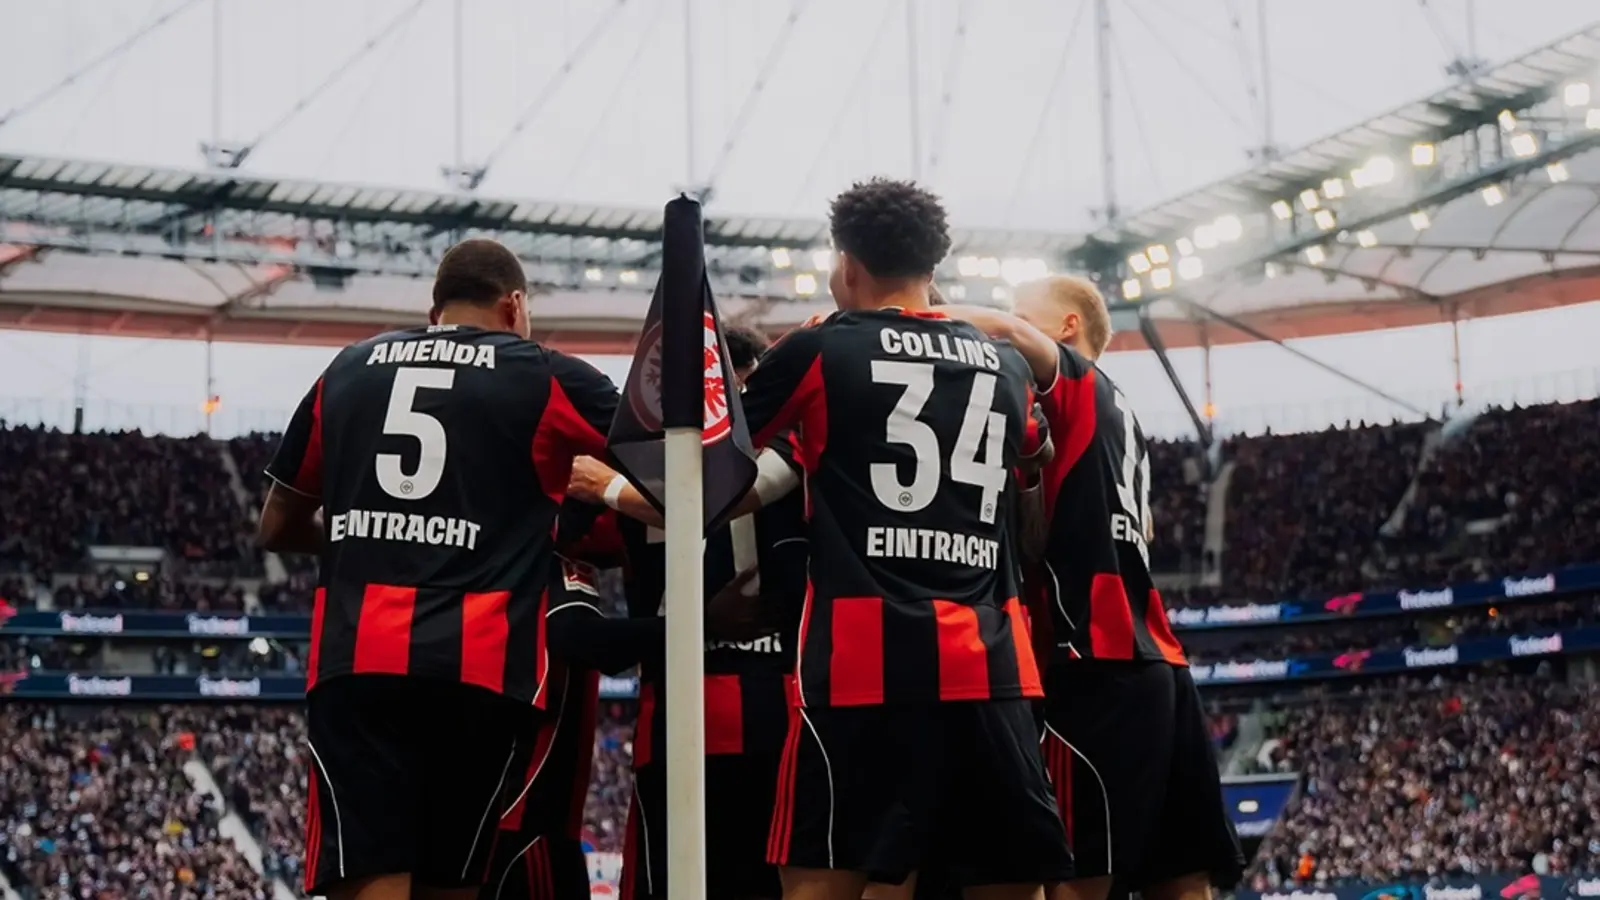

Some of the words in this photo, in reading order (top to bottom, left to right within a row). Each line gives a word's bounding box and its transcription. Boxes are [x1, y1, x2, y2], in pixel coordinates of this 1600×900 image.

[366, 339, 496, 370] AMENDA
[880, 327, 1001, 372] COLLINS
[375, 367, 456, 500] 5
[868, 360, 1008, 525] 34
[866, 526, 999, 571] EINTRACHT
